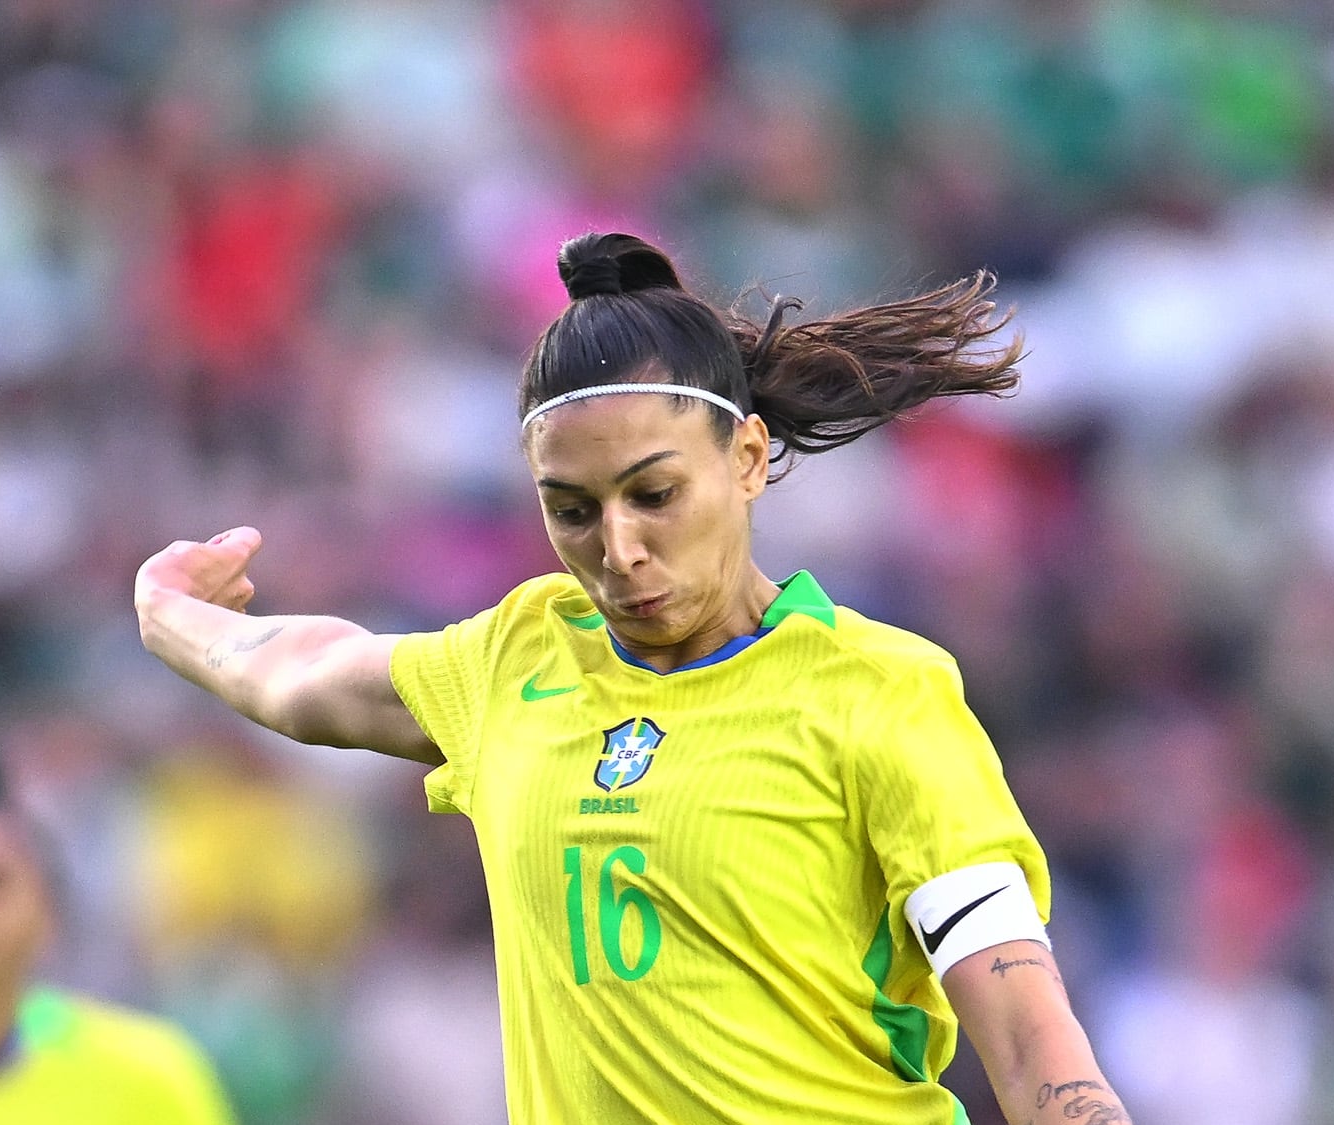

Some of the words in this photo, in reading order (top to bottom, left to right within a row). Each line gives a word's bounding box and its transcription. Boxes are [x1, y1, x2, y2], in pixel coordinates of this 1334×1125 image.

[617, 749, 641, 760] CBF
[578, 797, 640, 815] BRASIL
[563, 845, 662, 986] 16
